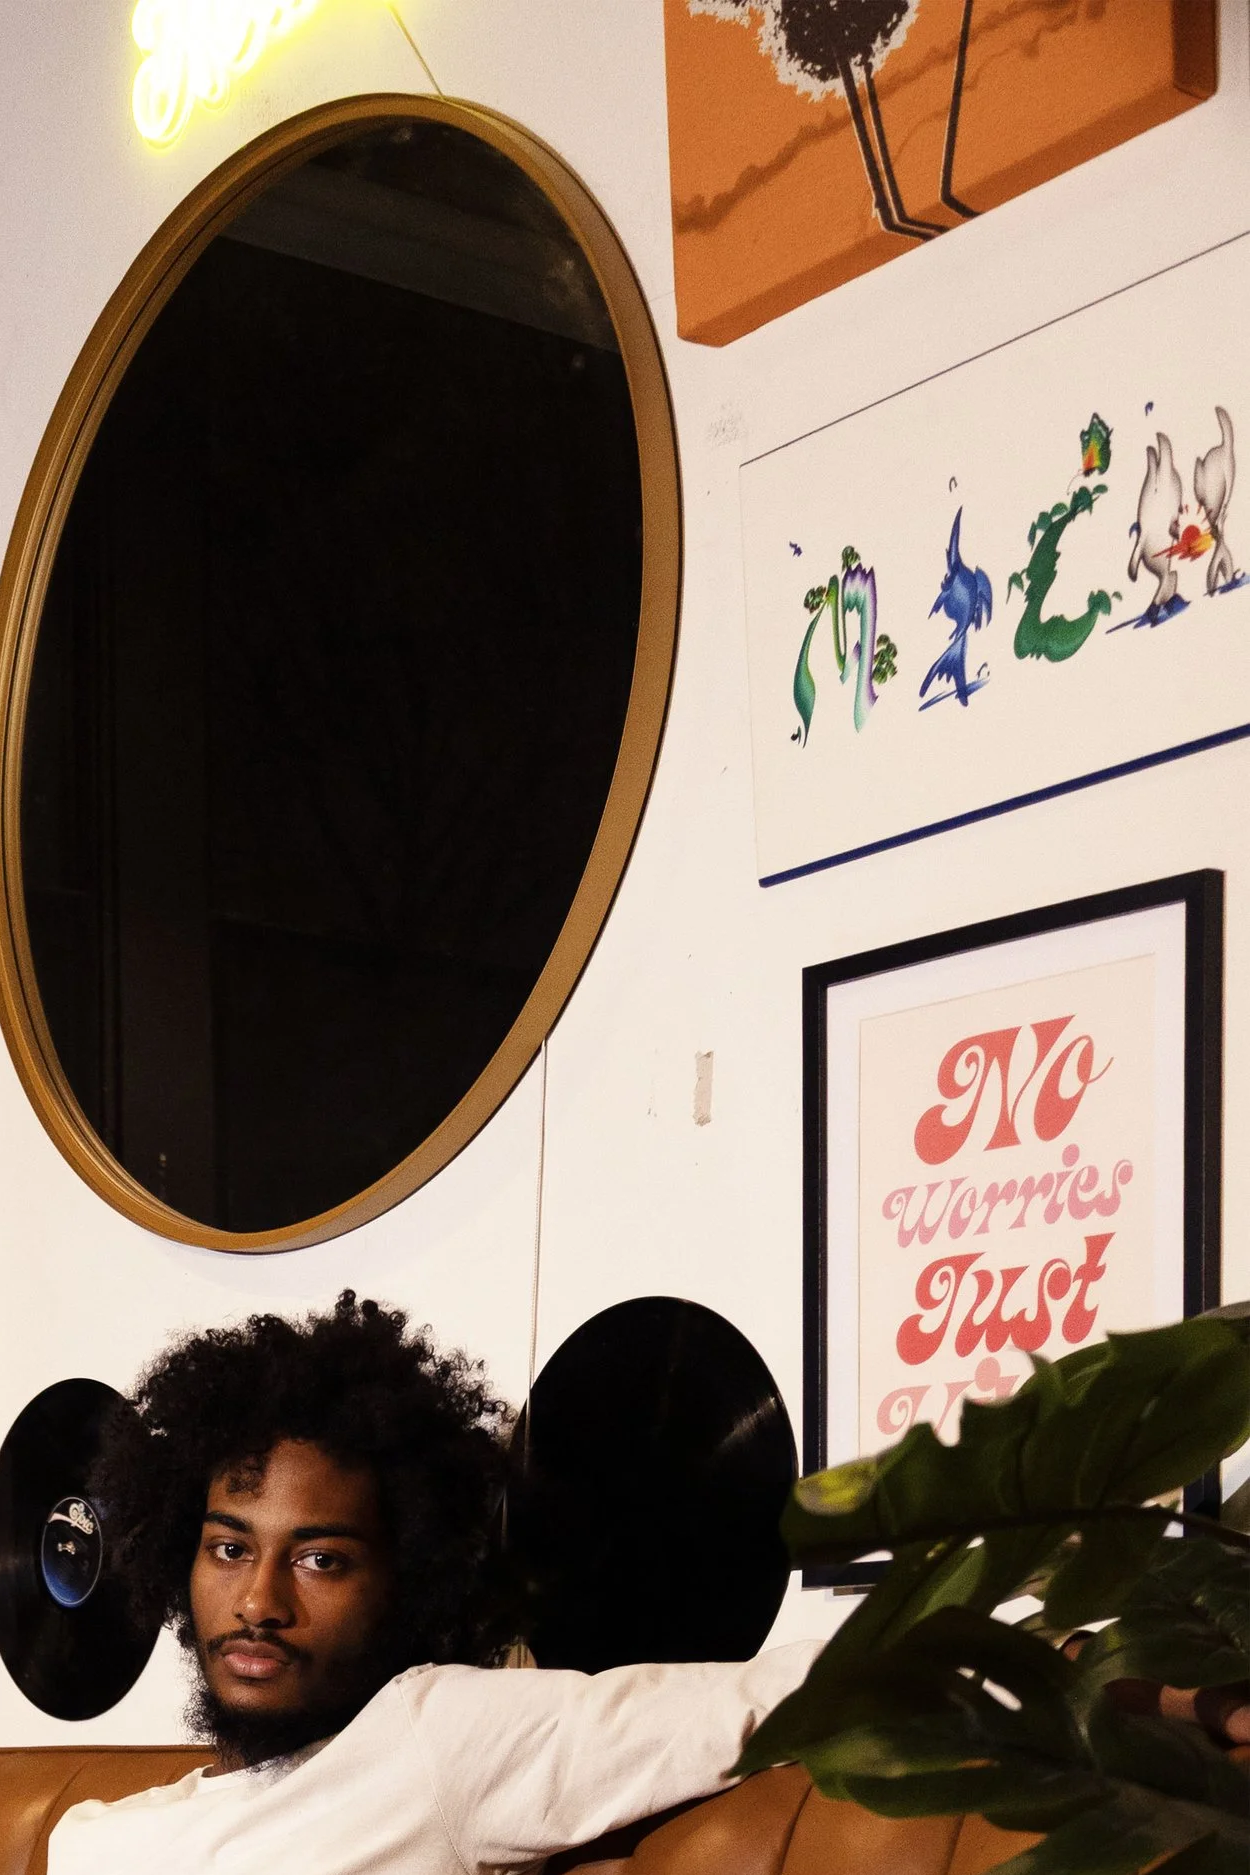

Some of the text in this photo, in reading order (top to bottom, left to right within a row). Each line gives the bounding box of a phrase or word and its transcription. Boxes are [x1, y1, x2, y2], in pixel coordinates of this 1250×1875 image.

[913, 1014, 1114, 1167] No
[882, 1143, 1134, 1249] Worries
[896, 1231, 1116, 1367] Just
[68, 1502, 94, 1535] Epic
